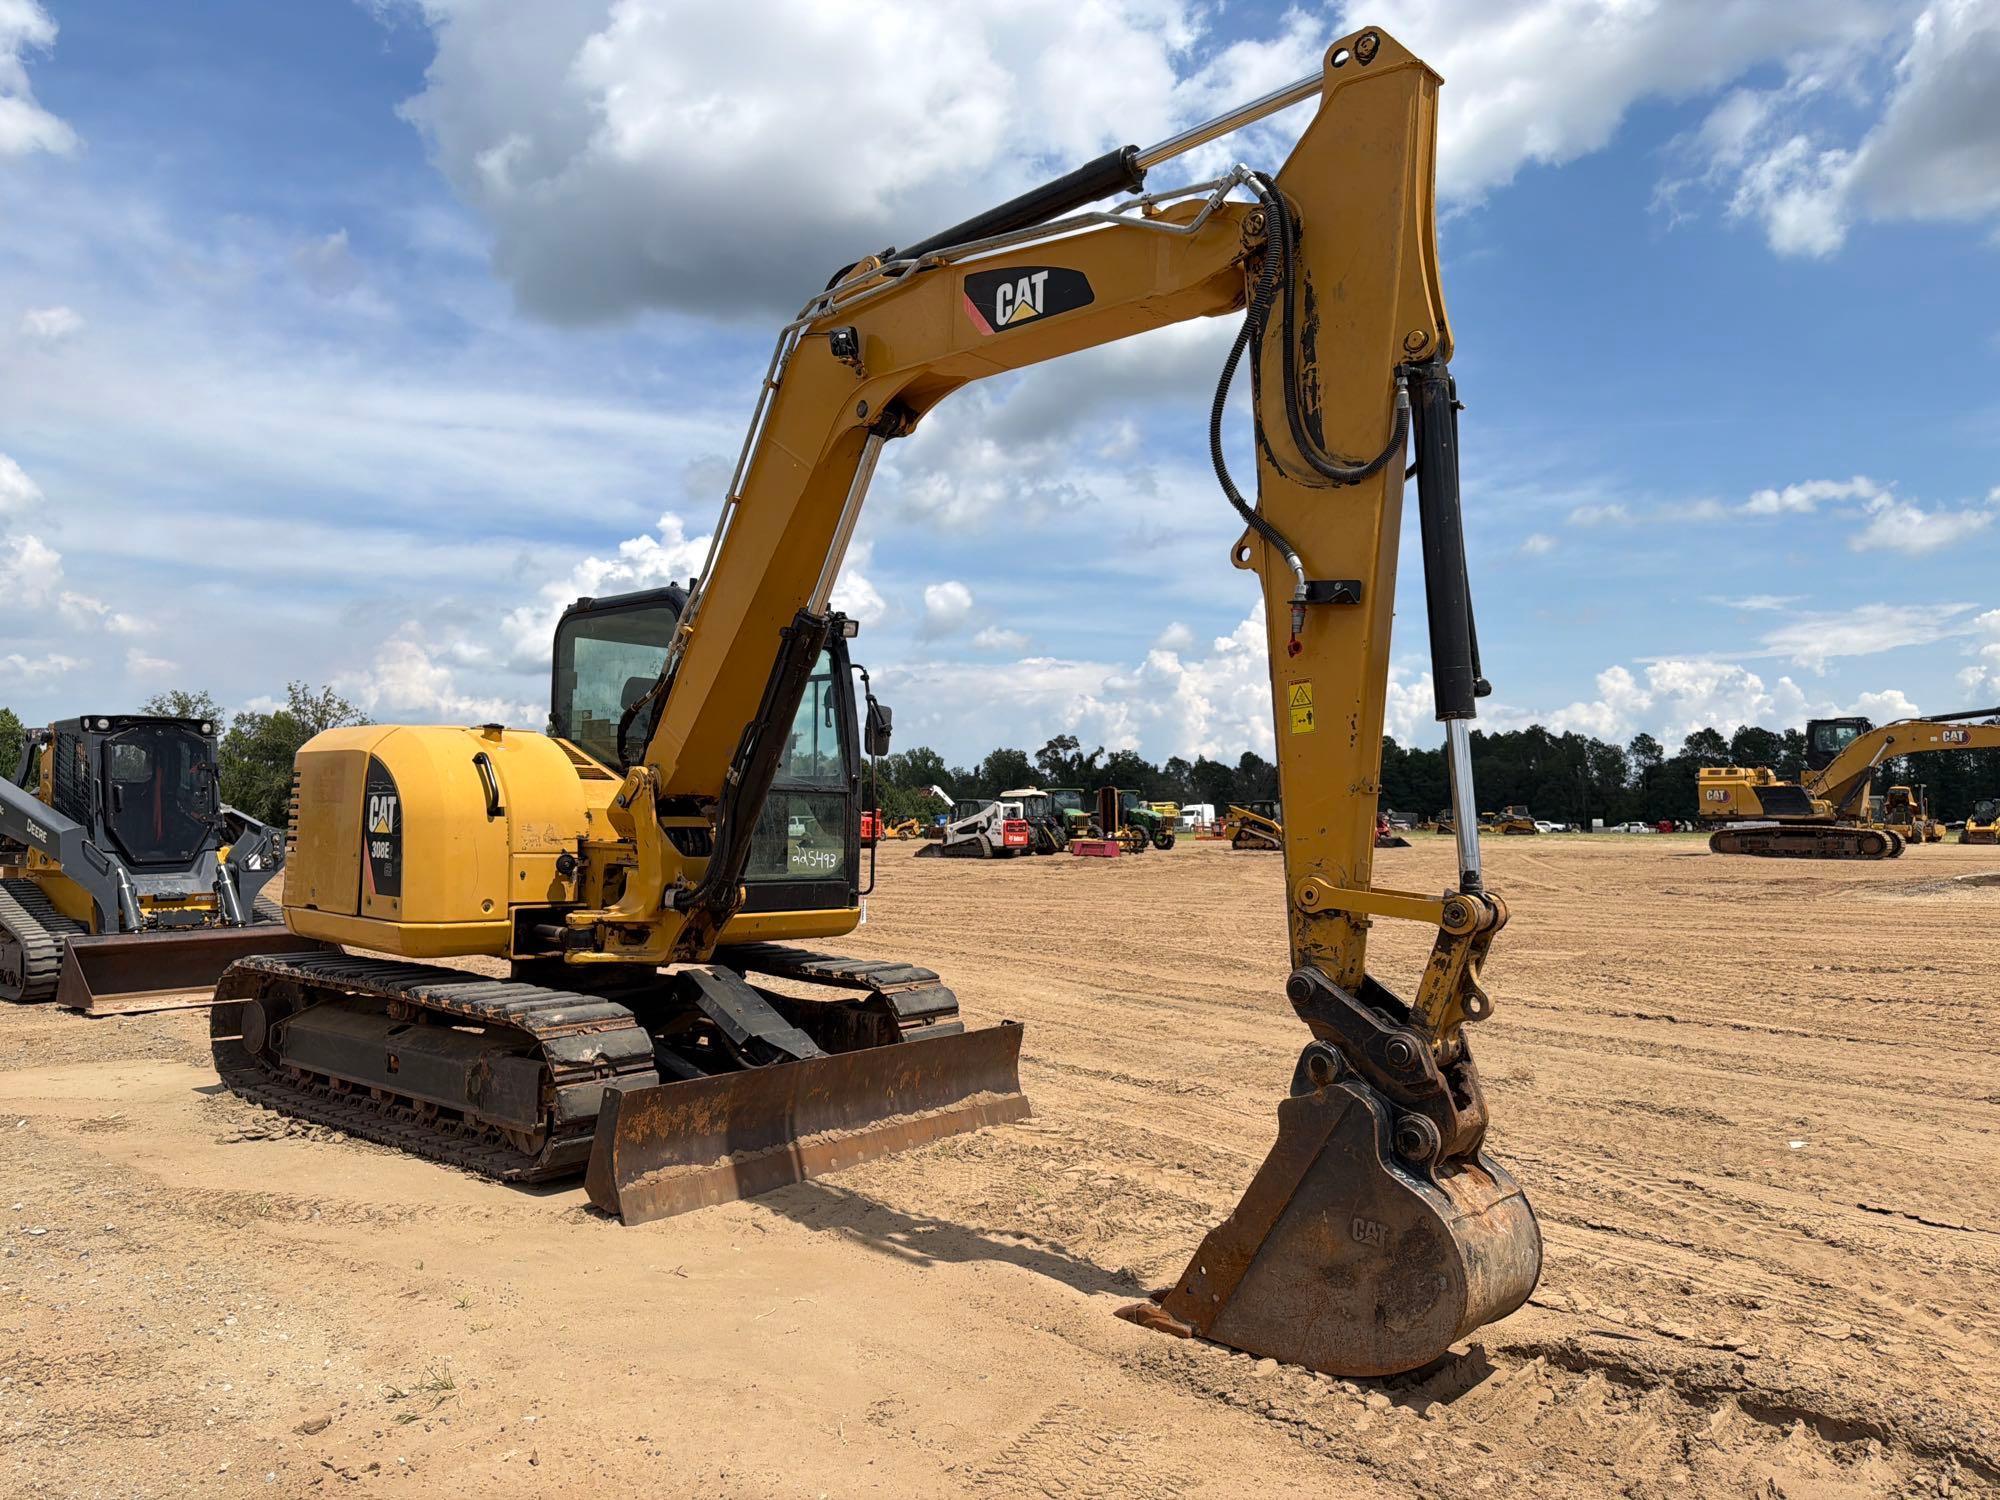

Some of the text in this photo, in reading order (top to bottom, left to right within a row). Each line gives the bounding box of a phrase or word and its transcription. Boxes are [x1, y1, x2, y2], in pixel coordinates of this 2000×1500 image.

[995, 270, 1049, 326] CAT
[1942, 730, 1964, 742] CAT
[1706, 790, 1725, 801] CAT
[368, 795, 397, 834] CAT
[26, 818, 48, 844] DEERE
[792, 845, 837, 869] 225493
[1352, 1217, 1388, 1248] CAT
